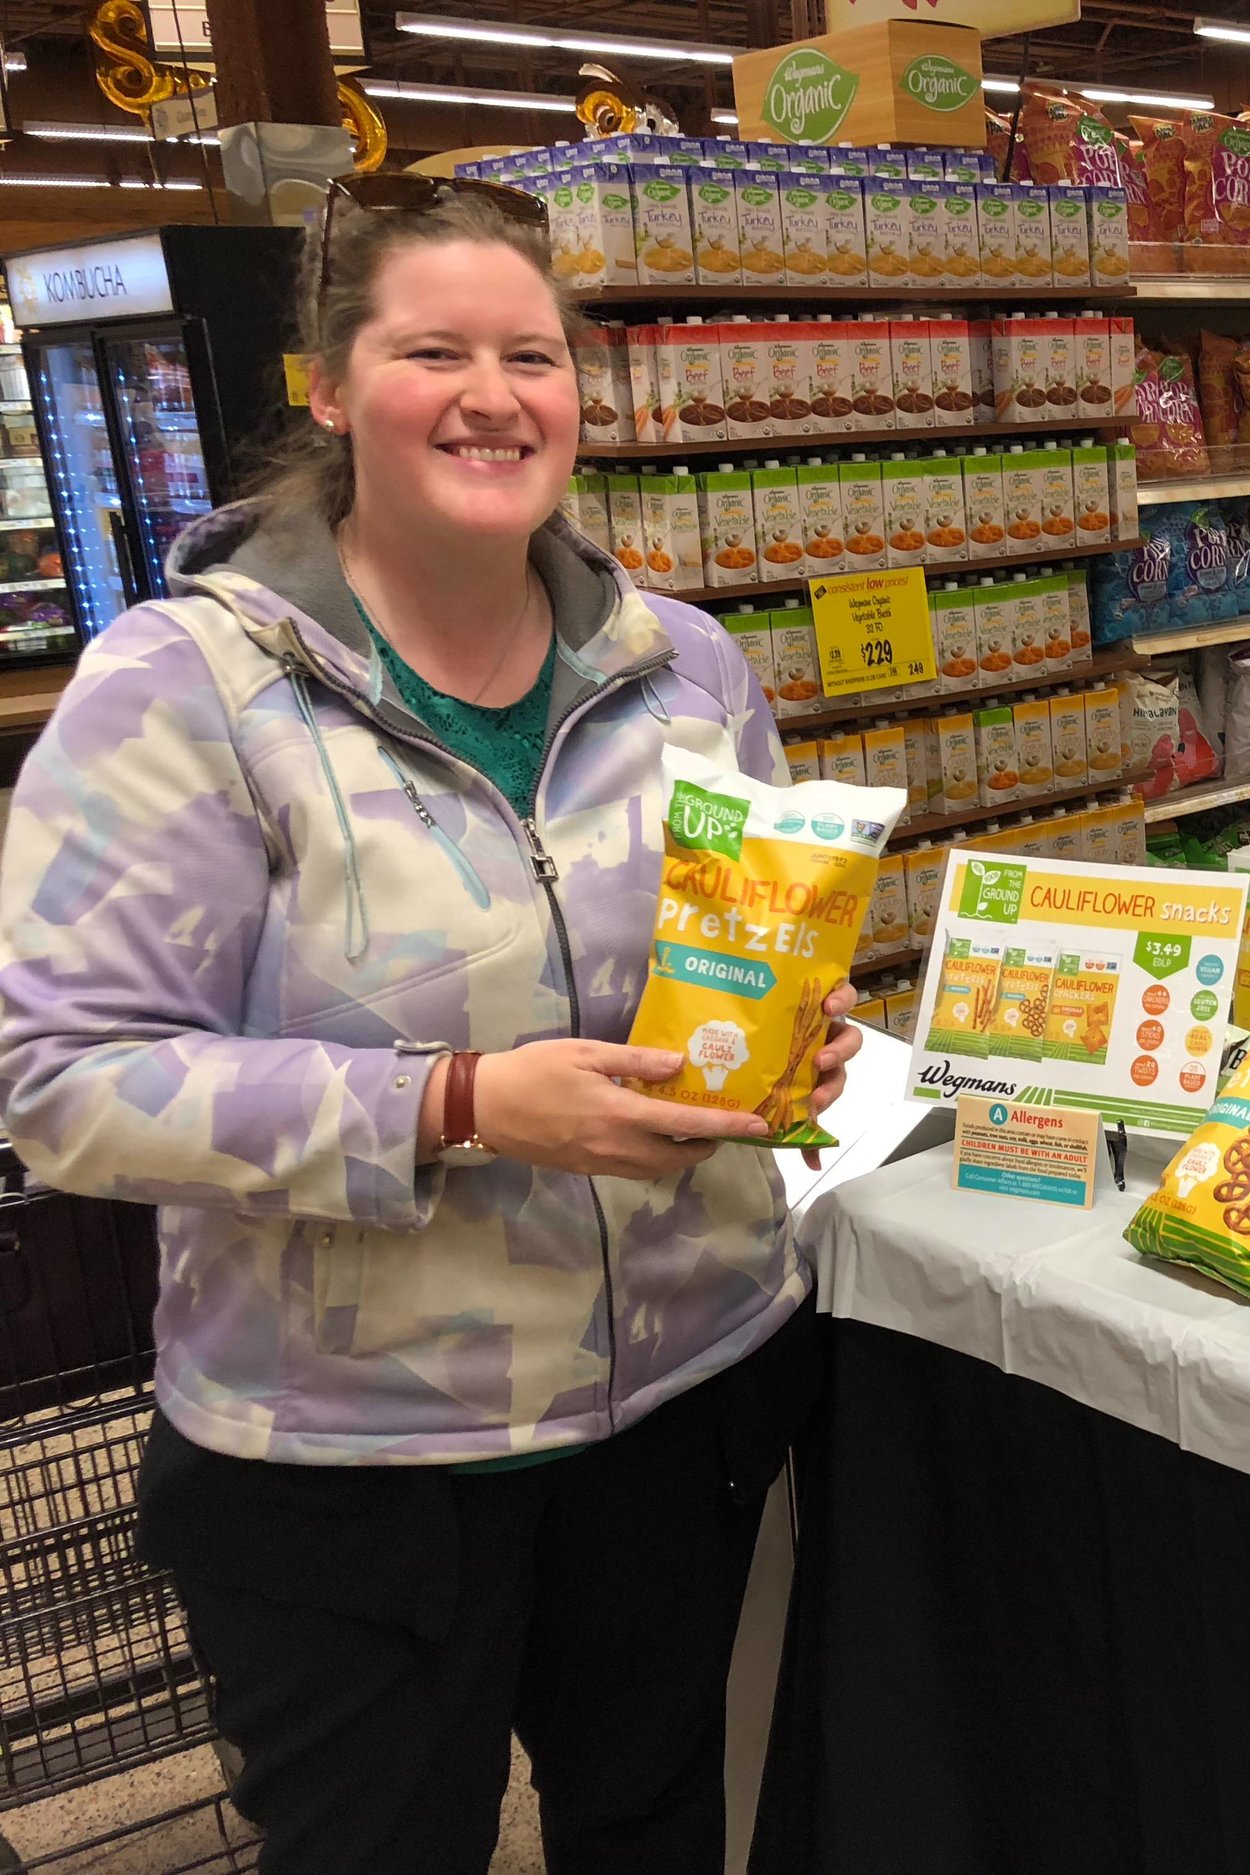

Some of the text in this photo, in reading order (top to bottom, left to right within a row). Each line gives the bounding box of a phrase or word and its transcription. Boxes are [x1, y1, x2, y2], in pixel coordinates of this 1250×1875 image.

[784, 61, 824, 87] Wegmans
[921, 61, 954, 76] Wegmans
[908, 70, 967, 102] Organic
[770, 74, 841, 134] Organic
[644, 209, 682, 228] Turkey
[43, 263, 127, 303] KOMBUCHA
[686, 369, 708, 383] Beef
[828, 582, 865, 594] consistent
[867, 578, 884, 592] low
[885, 576, 908, 589] prices!
[683, 793, 743, 823] GROUND
[683, 805, 722, 840] UP
[1004, 869, 1023, 878] FROM
[1009, 880, 1021, 888] THE
[663, 861, 858, 928] CAULIFLOWER
[982, 888, 1019, 902] GROUND
[1004, 903, 1017, 915] UP
[1030, 885, 1231, 926] CAULIFLOWER snacks
[1146, 940, 1181, 956] $3.49
[946, 960, 996, 974] CAULIFLOWER
[1153, 958, 1171, 967] EDLP
[684, 956, 767, 988] ORIGINAL
[1055, 978, 1114, 993] CAULIFLOWER
[698, 1051, 735, 1062] FLOWER
[702, 1043, 733, 1054] CAULI
[917, 1060, 1017, 1098] Wegmans
[659, 1085, 676, 1098] 4.5
[681, 1088, 698, 1100] OZ
[1011, 1111, 1063, 1129] Allergens
[962, 1140, 996, 1150] CHILDREN
[998, 1145, 1018, 1154] MUST
[1032, 1149, 1049, 1158] WITH
[1064, 1154, 1087, 1163] ADULT
